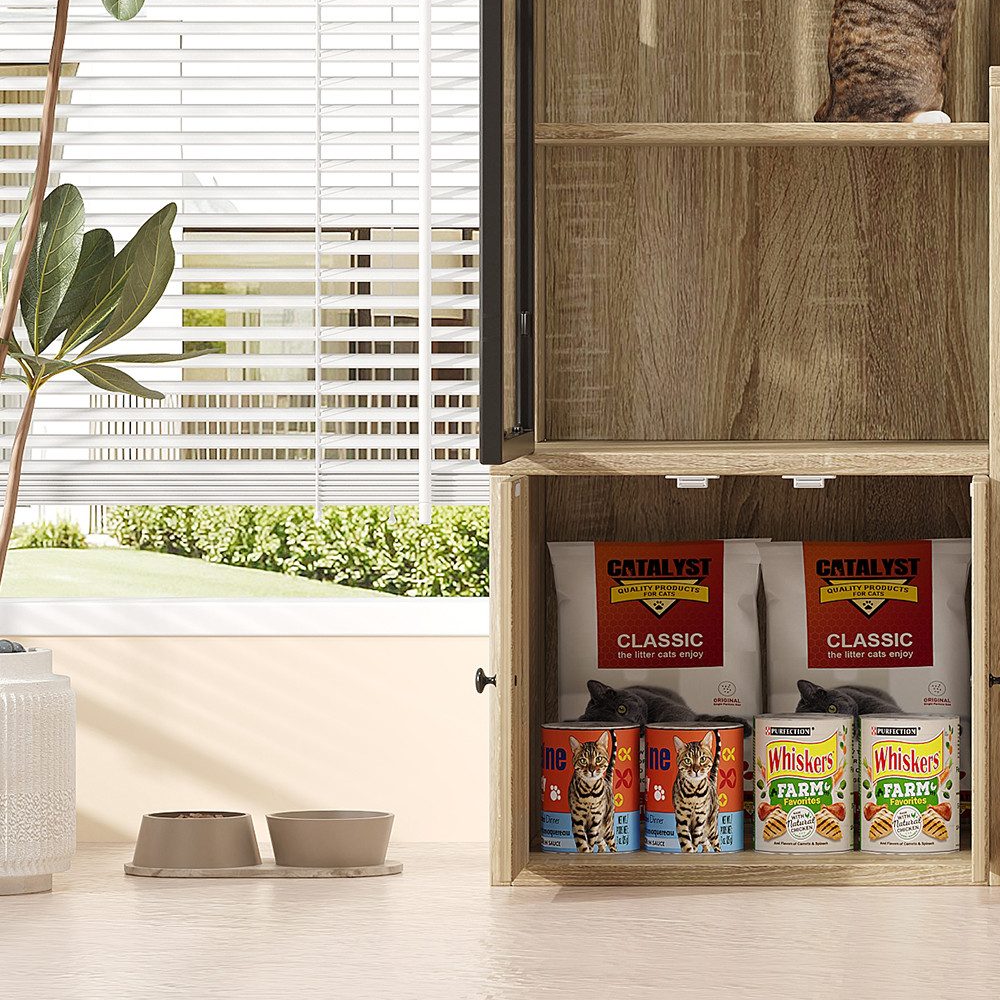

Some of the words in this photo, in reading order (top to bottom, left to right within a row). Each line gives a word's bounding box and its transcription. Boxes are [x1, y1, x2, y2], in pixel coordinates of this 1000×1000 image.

[607, 558, 712, 576] CATALYST
[816, 558, 920, 576] CATALYST
[618, 585, 653, 594] QUALITY
[655, 585, 700, 593] PRODUCTS
[827, 585, 862, 594] QUALITY
[864, 585, 909, 593] PRODUCTS
[617, 633, 704, 648] CLASSIC
[826, 632, 913, 648] CLASSIC
[618, 651, 632, 659] the
[679, 650, 704, 659] enjoy
[827, 651, 842, 659] the
[889, 650, 914, 659] enjoy
[769, 746, 833, 773] Whiskers
[875, 746, 939, 773] Whiskers
[777, 781, 824, 798] FARM
[883, 781, 930, 798] FARM
[784, 797, 821, 806] Favorites
[890, 797, 927, 806] Favorites
[787, 817, 815, 828] Natural
[893, 817, 921, 828] Natural
